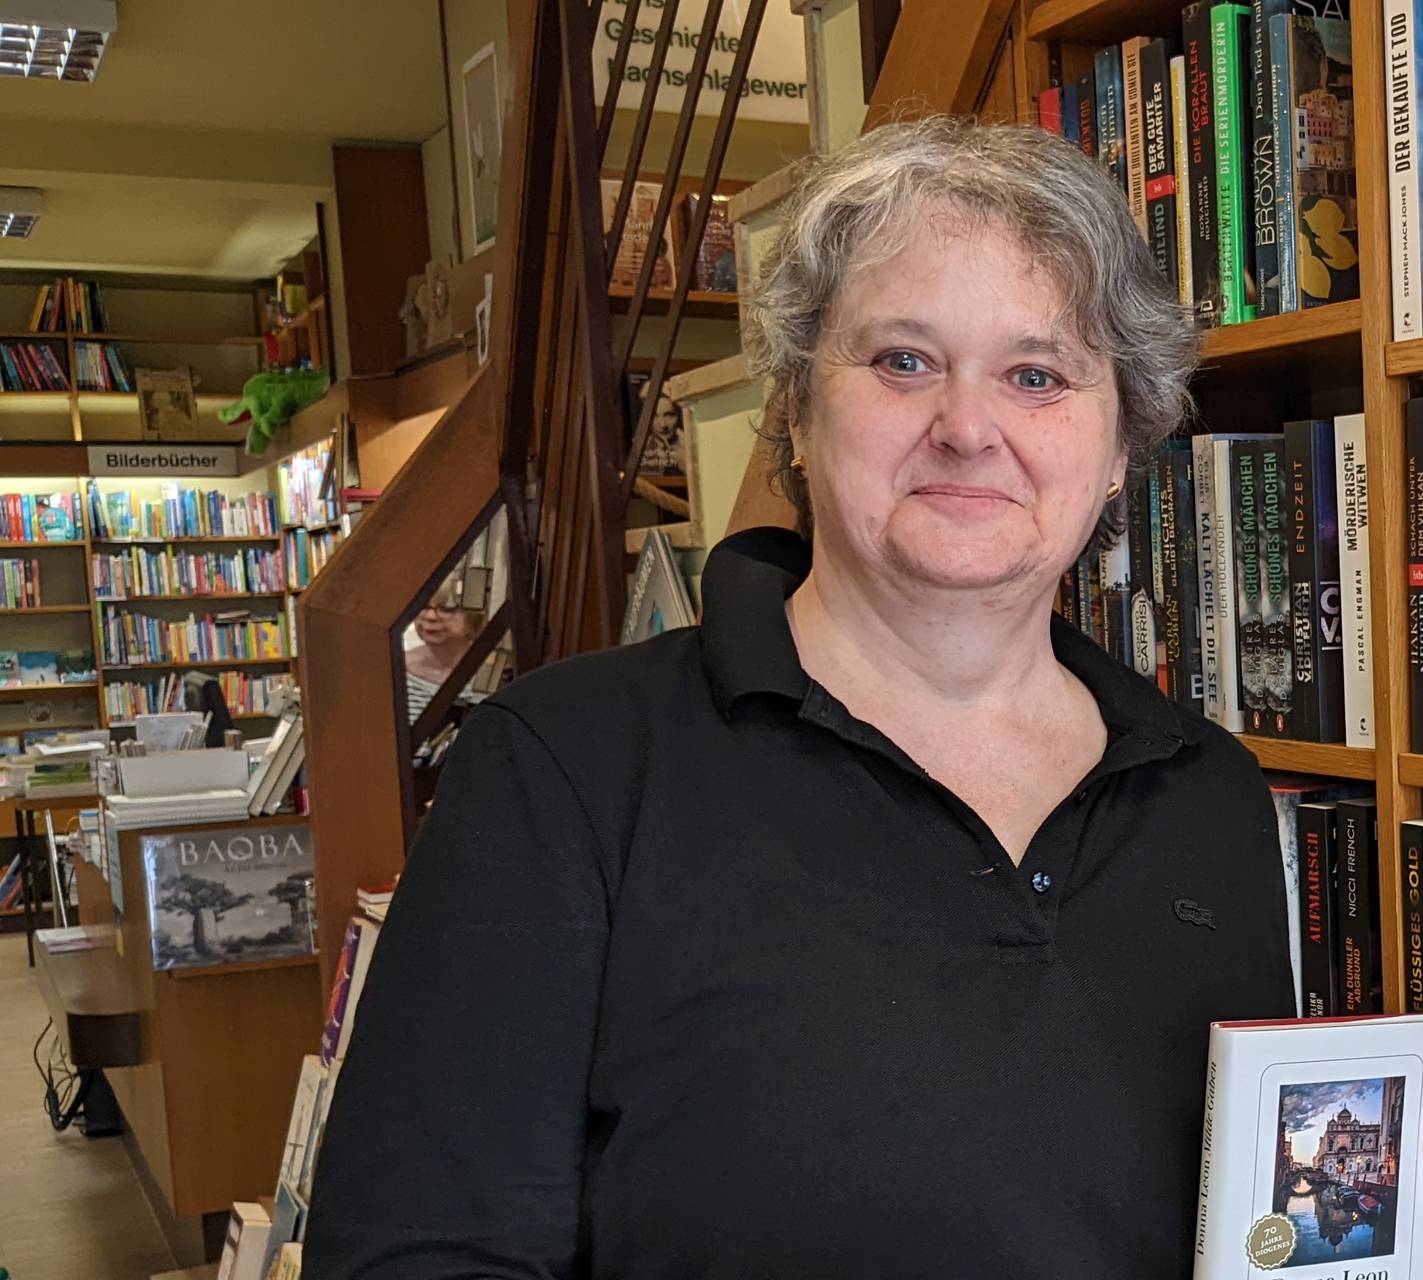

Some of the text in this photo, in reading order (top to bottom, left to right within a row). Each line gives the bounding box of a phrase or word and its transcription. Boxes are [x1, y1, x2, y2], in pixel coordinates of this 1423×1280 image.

[1154, 82, 1165, 170] SAMARITER
[1190, 40, 1201, 165] DIE KORALLEN
[1390, 12, 1411, 173] DER GEKAUFTE TOD
[1259, 135, 1274, 246] BROWN
[106, 453, 218, 468] Bilderbücher
[1264, 452, 1277, 528] MÄDCHEN
[1344, 442, 1357, 551] MÖRDERISCHE
[1357, 464, 1367, 528] WITWEN
[1201, 512, 1217, 704] KALT LÄCHELT DIE SEE
[179, 834, 305, 867] BAOBA
[1307, 832, 1321, 944] AUFMARSCH
[1408, 847, 1423, 1012] FLÜSSIGES GOLD
[1207, 1062, 1218, 1113] Gaben
[1200, 1160, 1211, 1198] Leon
[1196, 1202, 1208, 1255] Donna
[1255, 1241, 1290, 1257] DIOGENES
[1260, 1235, 1283, 1248] JAHRE
[1264, 1226, 1277, 1236] 70
